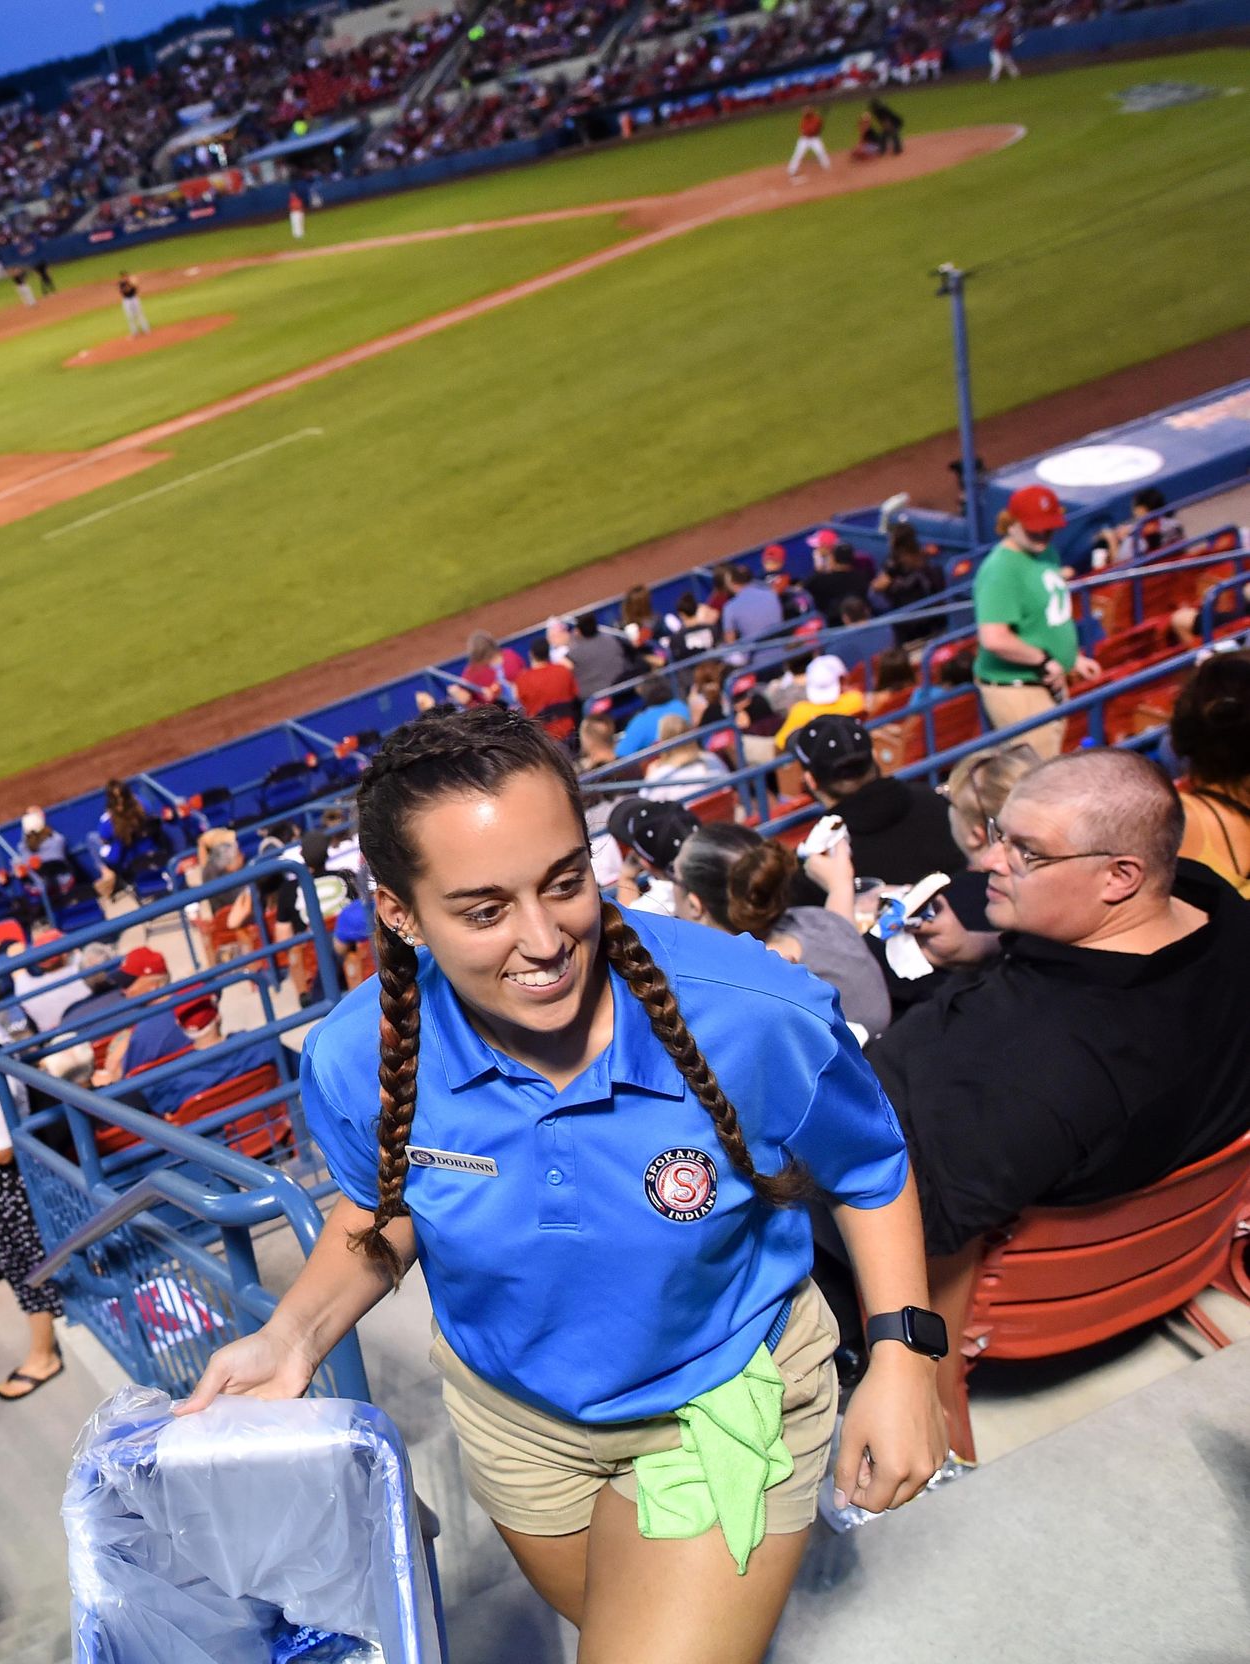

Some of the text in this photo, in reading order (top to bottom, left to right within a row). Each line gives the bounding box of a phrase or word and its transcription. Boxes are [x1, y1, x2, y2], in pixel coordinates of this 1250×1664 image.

[436, 1156, 494, 1173] DORIANN
[646, 1150, 706, 1182] SPOKANE
[668, 1190, 717, 1221] INDIANS
